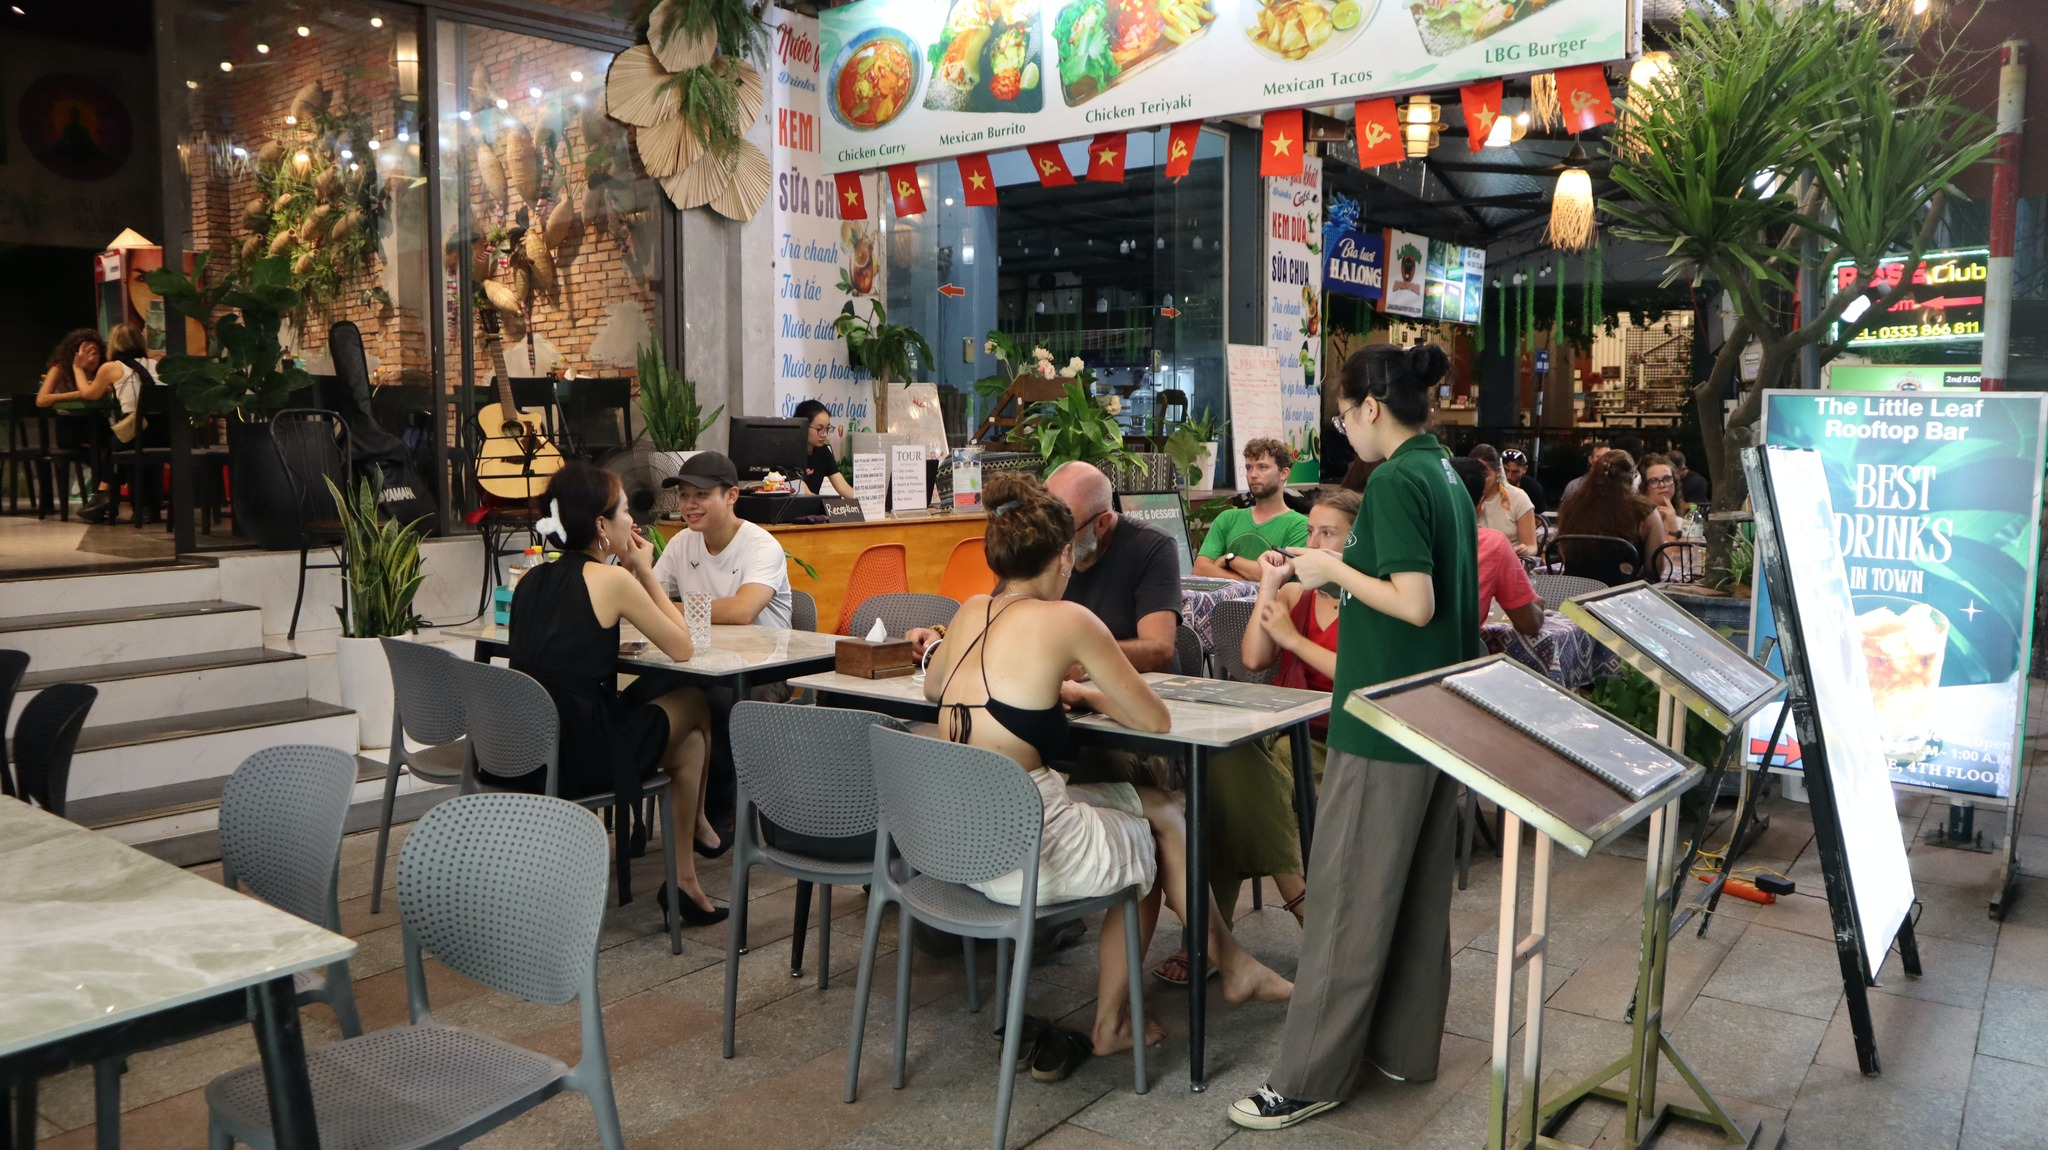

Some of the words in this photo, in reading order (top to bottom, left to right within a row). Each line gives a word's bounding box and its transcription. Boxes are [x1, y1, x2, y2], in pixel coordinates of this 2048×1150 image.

[1485, 44, 1521, 65] LBG
[1528, 37, 1588, 59] Burger
[777, 70, 818, 93] Drinks
[1262, 75, 1325, 97] Mexican
[1331, 67, 1373, 87] Tacos
[1085, 100, 1136, 124] Chicken
[1140, 93, 1192, 115] Teriyaki
[778, 107, 813, 152] KEM
[939, 129, 984, 146] Mexican
[987, 122, 1026, 139] Burrito
[838, 146, 876, 162] Chicken
[879, 143, 907, 156] Curry
[779, 166, 810, 215] SỮA
[1273, 211, 1289, 240] KEM
[781, 234, 801, 260] Trà
[804, 238, 838, 264] chanh
[1272, 251, 1287, 283] SỮA
[1289, 258, 1309, 286] CHUA
[1932, 262, 1987, 284] Club
[781, 273, 801, 300] Trà
[804, 275, 822, 301] tắc
[781, 313, 811, 339] Nước
[1879, 325, 1918, 339] 0333
[1921, 322, 1951, 336] 866
[1953, 320, 1979, 334] 811
[782, 353, 812, 379] Nước
[814, 359, 827, 384] ép
[1945, 375, 1962, 383] 2nd
[1814, 397, 1858, 416] The
[1864, 397, 1924, 418] Little
[1930, 398, 1985, 418] Leaf
[1825, 419, 1920, 444] Rooftop
[1925, 421, 1970, 442] Bar
[897, 451, 922, 461] TOUR
[1854, 463, 1937, 511] BEST
[826, 503, 860, 516] Reception
[1144, 509, 1150, 519] &
[1150, 508, 1180, 519] DESSERT
[1835, 512, 1954, 563] DRINKS
[1850, 566, 1867, 590] IN
[1872, 568, 1924, 594] TOWN
[1951, 748, 1979, 762] 1:00
[1974, 736, 2011, 751] Open
[1906, 761, 1942, 777] 4TH
[1945, 766, 2007, 786] FLOOR
